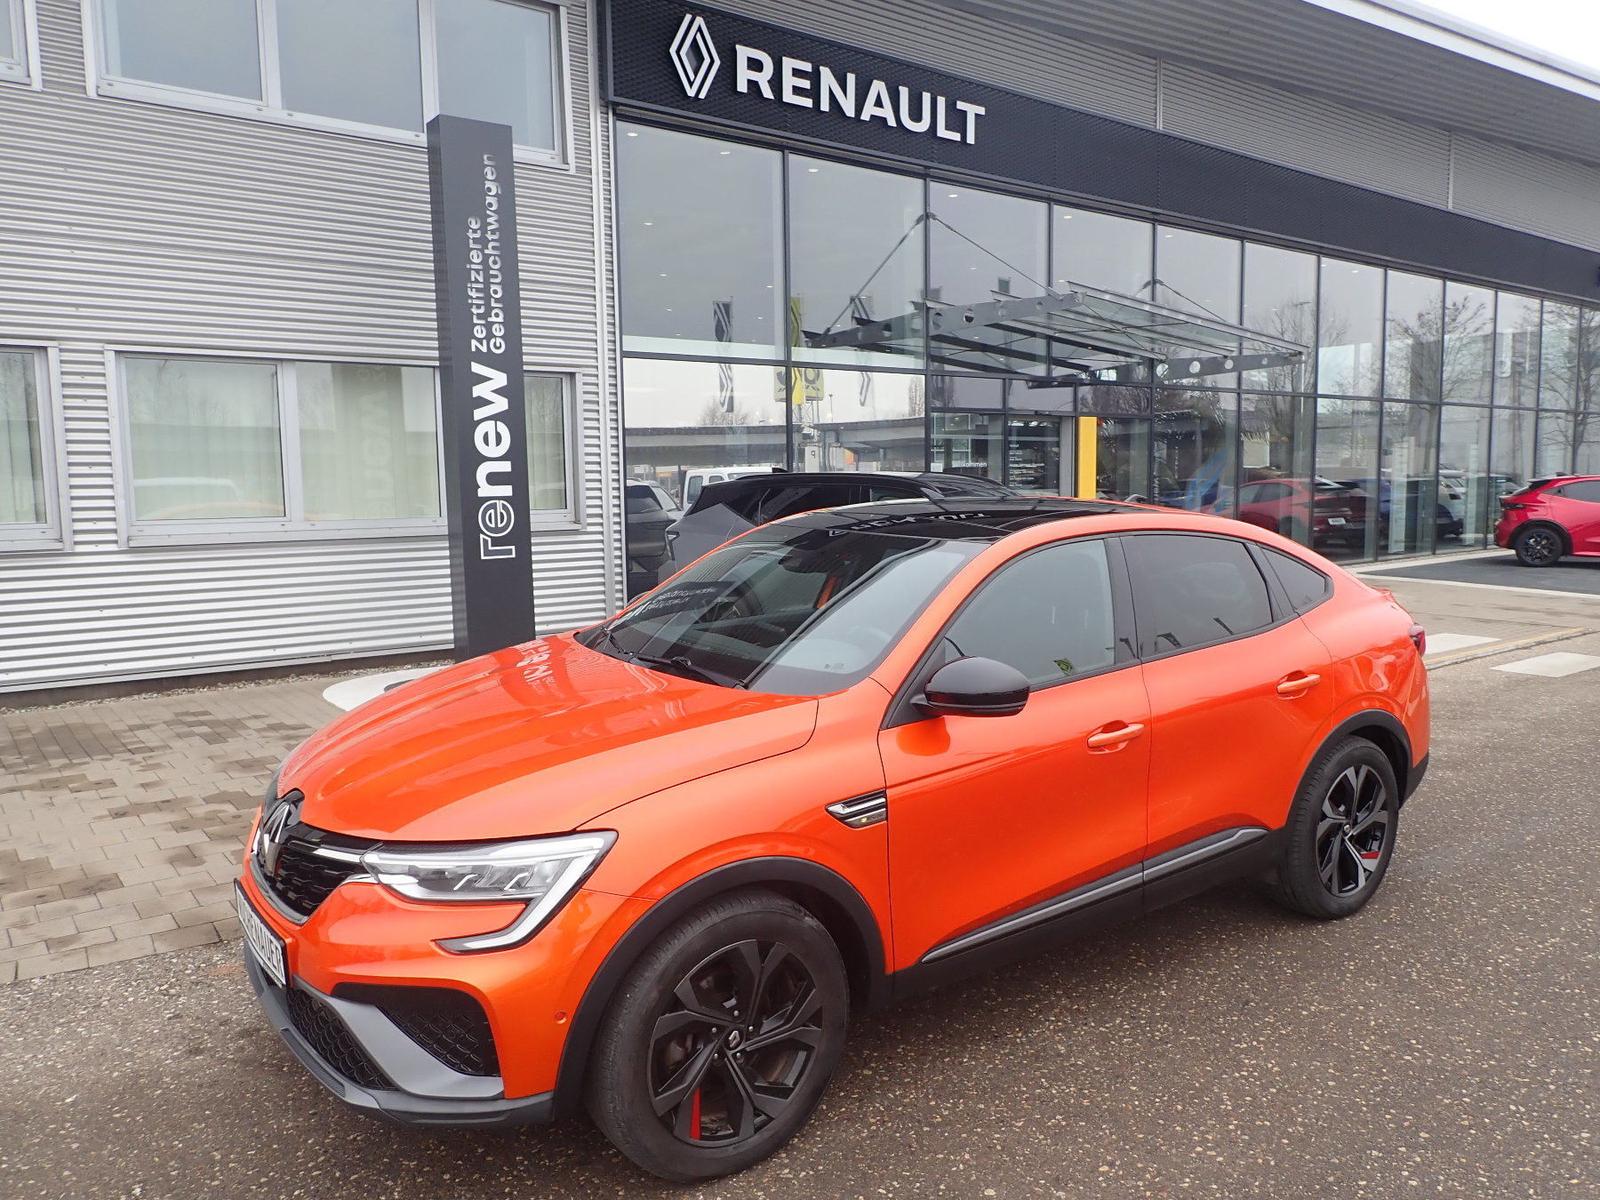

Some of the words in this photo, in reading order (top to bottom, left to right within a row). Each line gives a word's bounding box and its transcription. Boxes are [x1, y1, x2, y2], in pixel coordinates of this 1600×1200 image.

[735, 44, 986, 145] RENAULT
[466, 216, 488, 353] Zertifizierte
[482, 154, 506, 355] Gebrauchtwagen
[470, 361, 516, 560] renew
